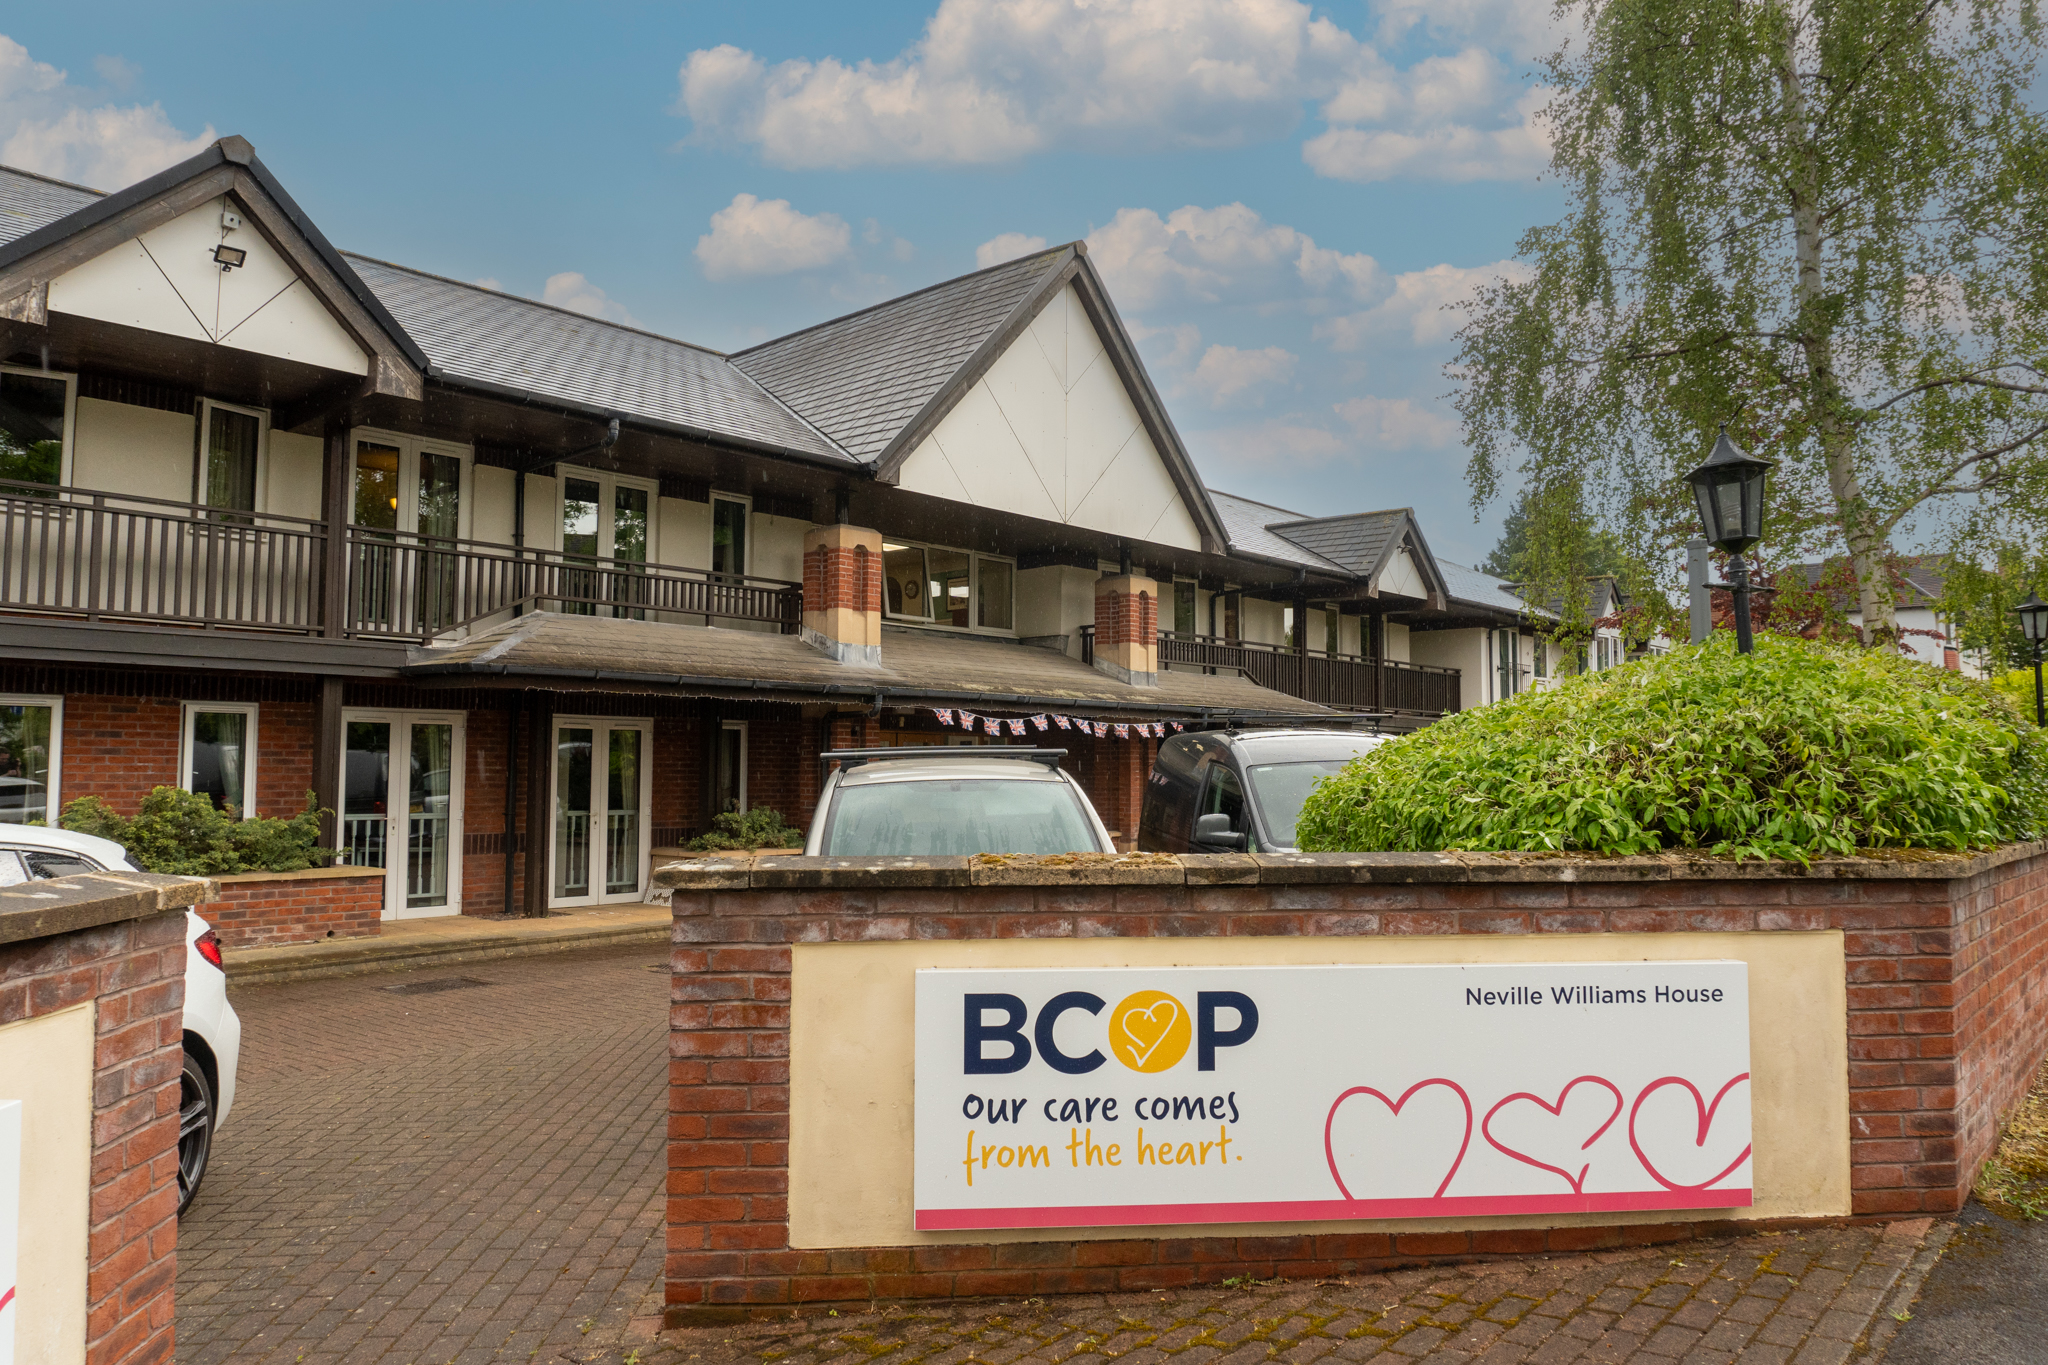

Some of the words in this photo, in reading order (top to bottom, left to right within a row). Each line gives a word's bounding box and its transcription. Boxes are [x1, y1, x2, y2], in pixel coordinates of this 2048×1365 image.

[1466, 986, 1543, 1006] Neville
[1550, 985, 1647, 1005] Williams
[1655, 985, 1724, 1004] House
[1043, 1097, 1119, 1124] care
[1134, 1091, 1240, 1124] comes
[962, 1129, 1051, 1187] from
[1064, 1128, 1123, 1168] the
[1138, 1124, 1243, 1166] heart.
